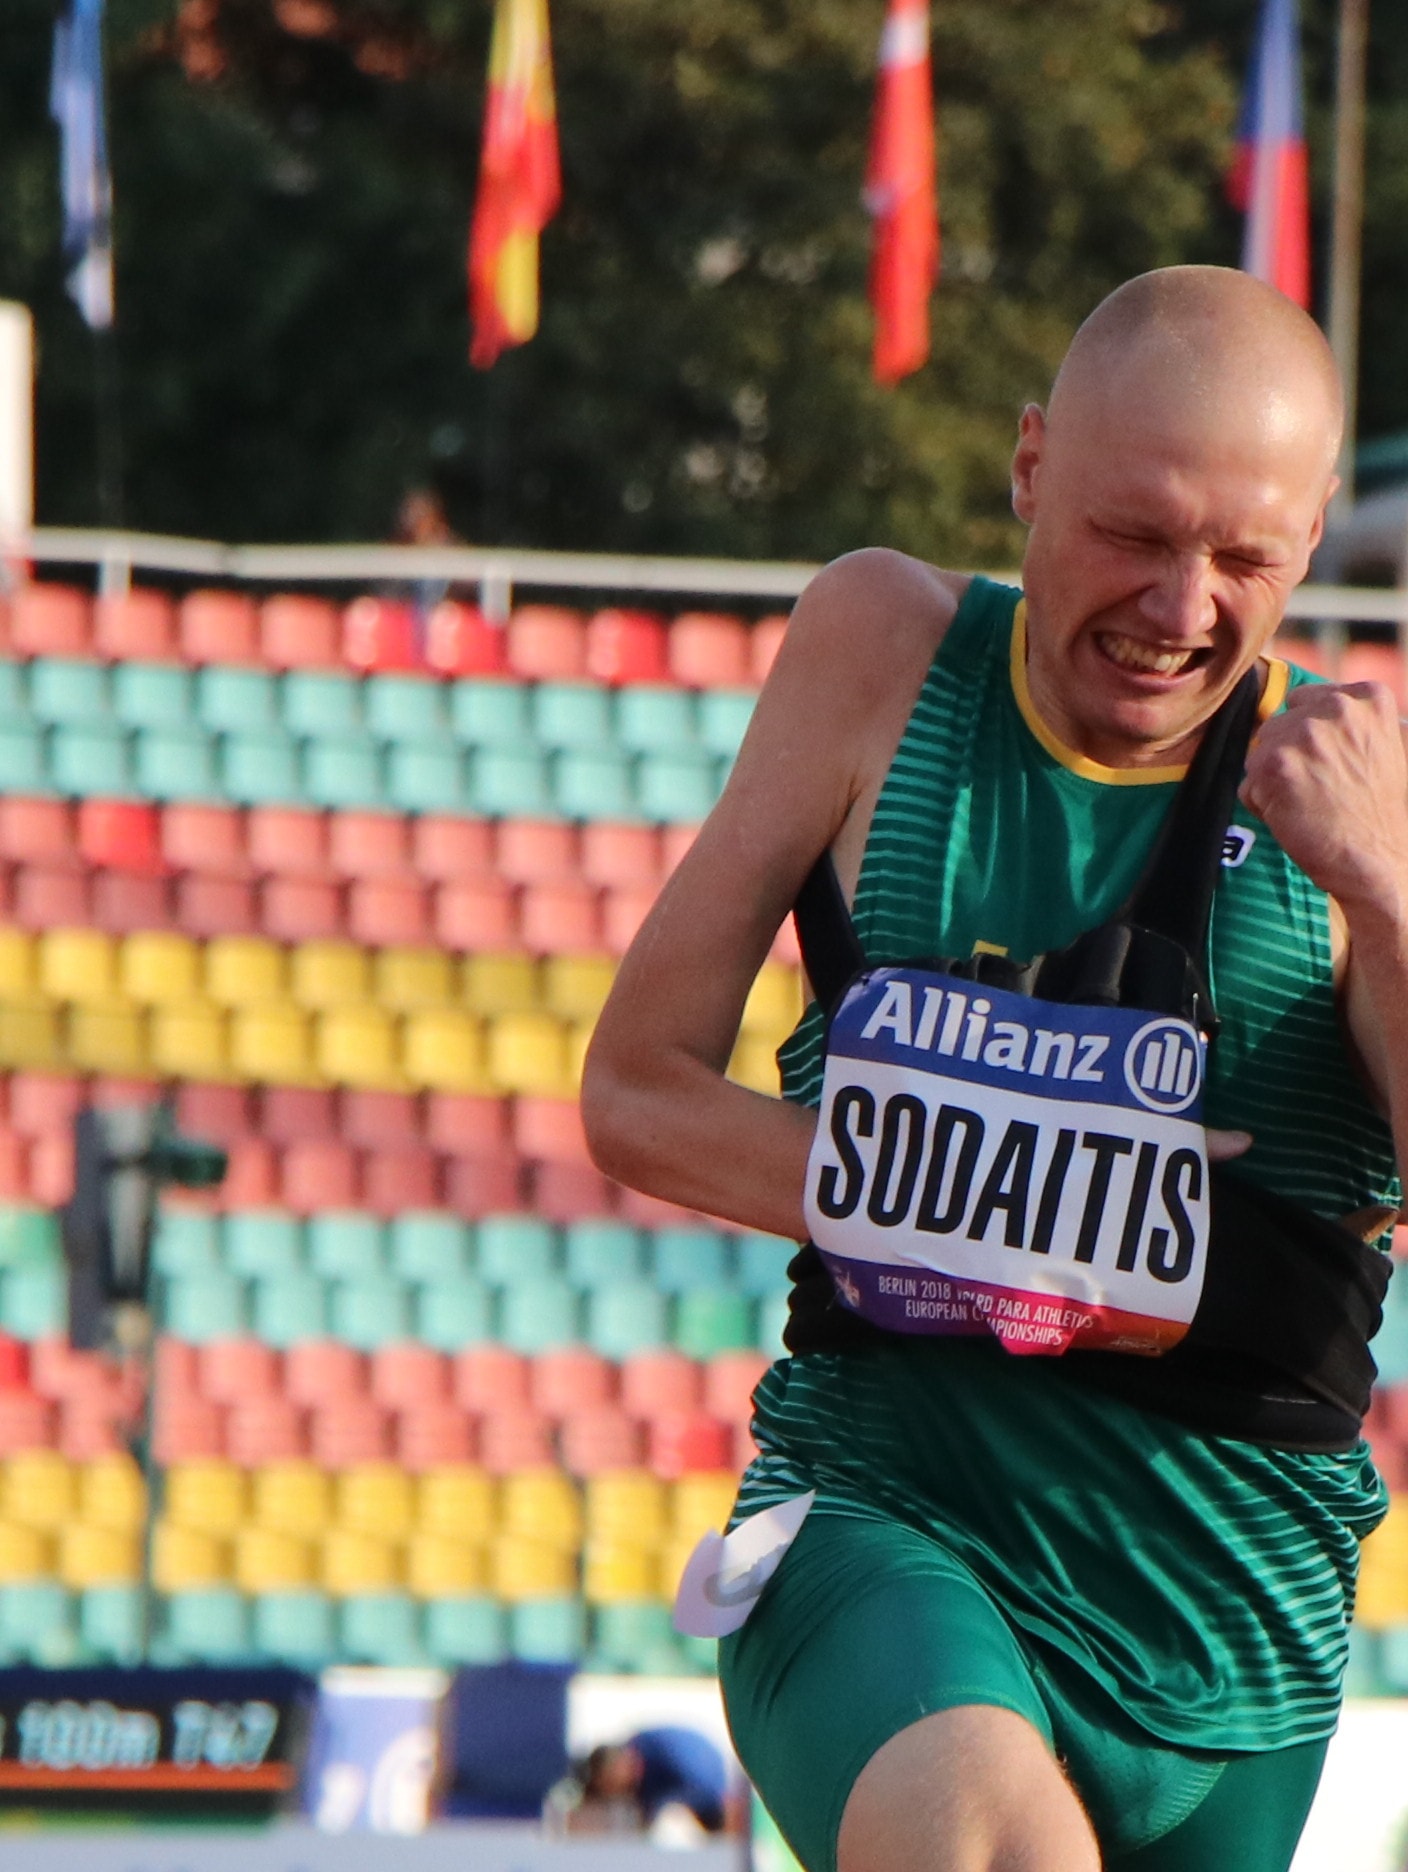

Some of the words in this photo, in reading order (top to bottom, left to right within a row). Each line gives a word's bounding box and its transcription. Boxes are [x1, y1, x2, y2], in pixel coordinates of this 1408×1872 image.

[861, 980, 1111, 1083] Allianz
[816, 1085, 1201, 1283] SODAITIS
[878, 1275, 917, 1298] BERLIN
[920, 1279, 951, 1300] 2018
[996, 1298, 1030, 1321] PARA
[905, 1299, 968, 1321] EUROPEAN
